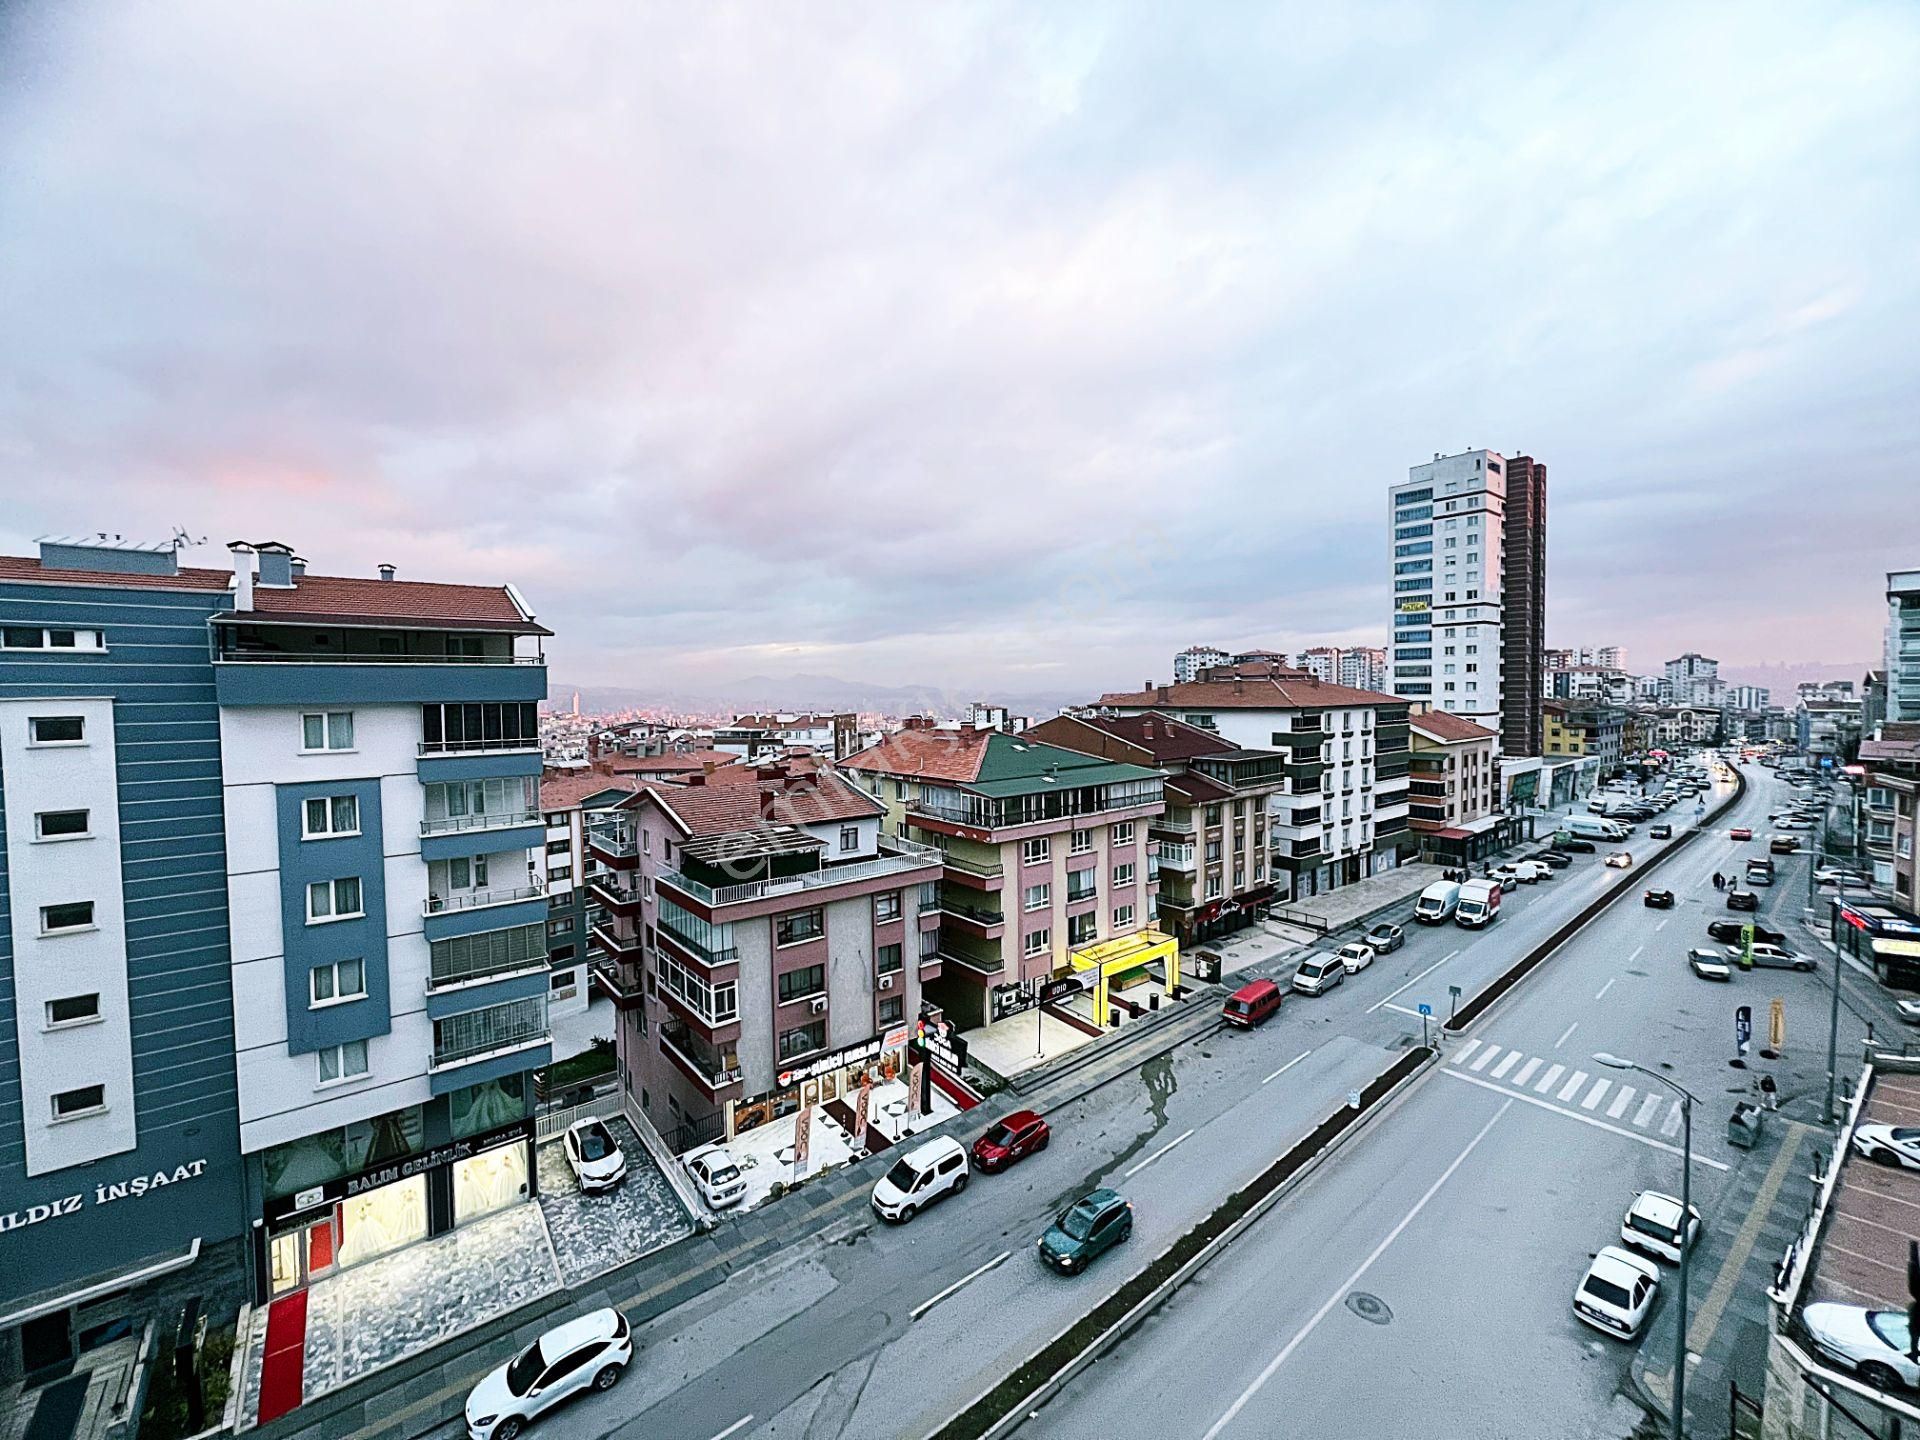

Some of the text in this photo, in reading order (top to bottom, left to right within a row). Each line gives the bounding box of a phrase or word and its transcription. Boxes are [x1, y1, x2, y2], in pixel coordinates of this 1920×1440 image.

[95, 1159, 207, 1205] İNŞAAT
[347, 1142, 473, 1194] BALIM GELİNLİK
